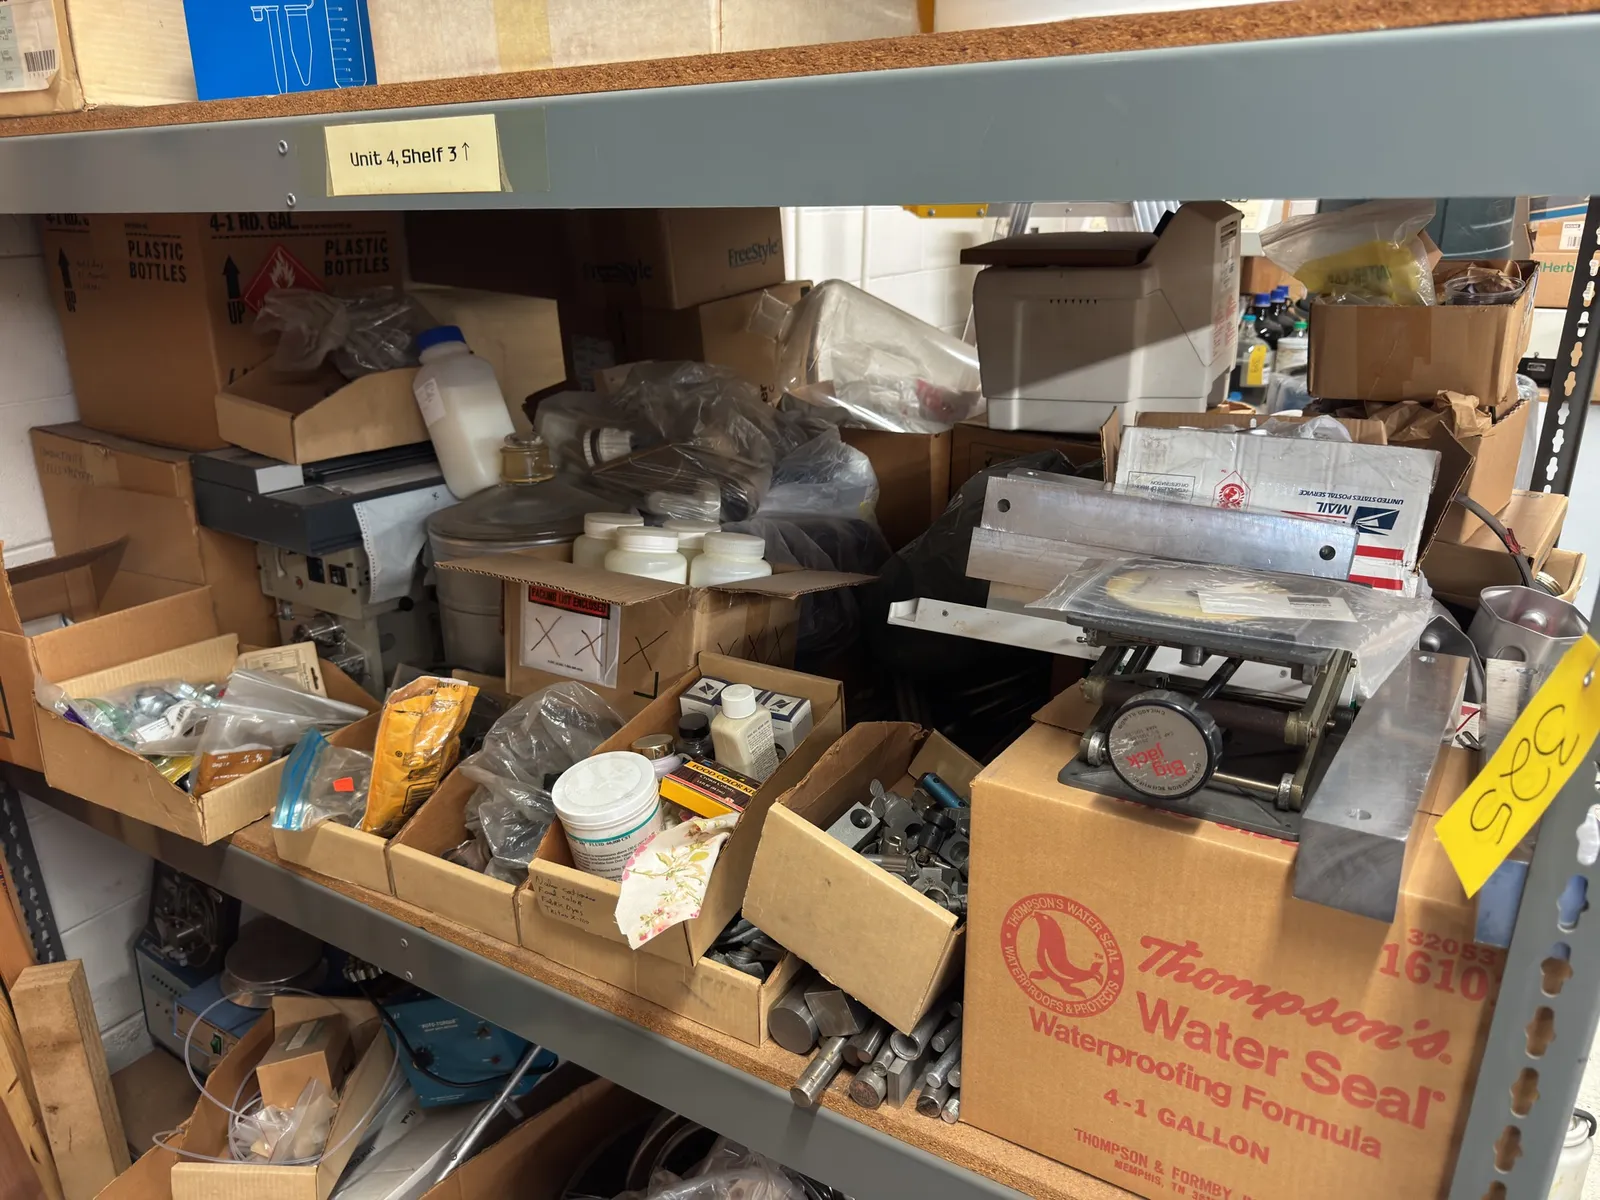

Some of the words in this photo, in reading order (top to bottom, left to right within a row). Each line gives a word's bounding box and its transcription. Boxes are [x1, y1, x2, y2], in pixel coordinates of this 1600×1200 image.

[350, 151, 382, 167] Unit
[386, 150, 399, 168] 4,
[402, 147, 443, 164] Shelf
[448, 146, 457, 162] 3
[210, 212, 235, 232] 4-1
[128, 240, 184, 261] PLASTIC
[325, 237, 388, 256] PLASTIC
[728, 238, 777, 268] FreeStyle
[129, 262, 187, 284] BOTTLES
[324, 257, 390, 277] BOTTLES
[228, 300, 246, 324] UP
[1298, 490, 1326, 498] SERVICE
[1328, 492, 1352, 500] POSTAL
[1377, 496, 1404, 505] UNITED
[1316, 502, 1352, 515] MAIL
[1126, 742, 1165, 769] jack
[692, 764, 716, 777] FOOD
[716, 774, 744, 789] COLOR
[1151, 759, 1188, 780] Big
[1007, 897, 1064, 928] THOMPSON'S
[1066, 901, 1102, 933] WATER
[1100, 932, 1120, 964] SEAL
[1407, 928, 1498, 966] 32053
[1004, 946, 1064, 1012] WATERPROOFS
[1066, 1004, 1074, 1014] &
[1074, 980, 1120, 1014] PROTECTS
[1379, 942, 1489, 1002] 1610
[1136, 991, 1289, 1078] Water
[1028, 1006, 1232, 1109] Waterproofing
[1242, 1084, 1382, 1160] Formula
[1157, 1106, 1270, 1165] GALLON
[1074, 1128, 1148, 1169] THOMPSON
[1154, 1160, 1165, 1176] &
[1172, 1165, 1233, 1200] FORMBY
[1172, 1182, 1186, 1196] TN
